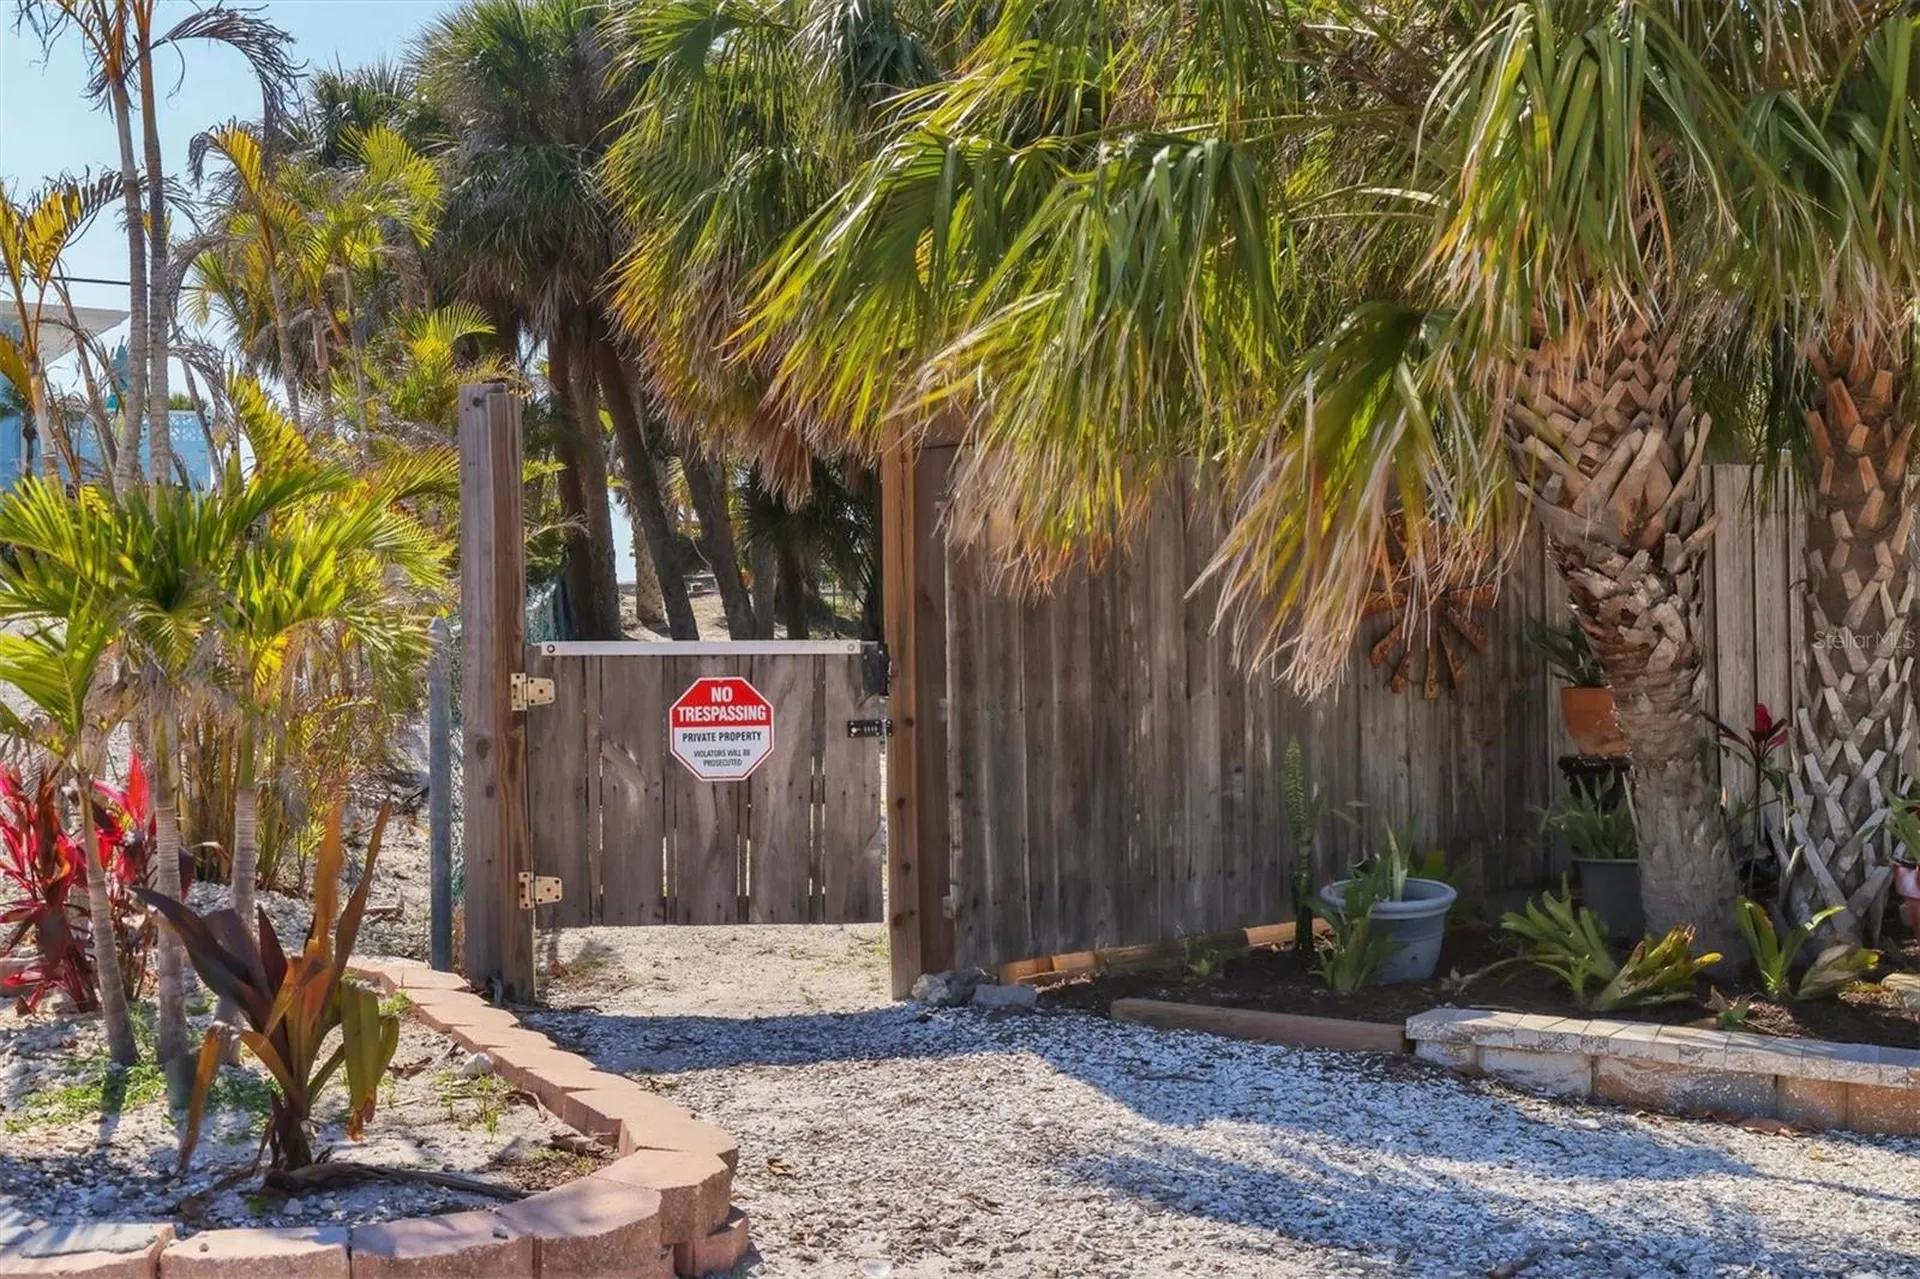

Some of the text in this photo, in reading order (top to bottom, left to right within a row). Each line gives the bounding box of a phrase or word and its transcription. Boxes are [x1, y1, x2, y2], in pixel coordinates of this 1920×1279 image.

[710, 686, 733, 703] NO
[677, 704, 767, 722] TRESPASSING
[682, 731, 762, 743] PRIVATE PROPERTY
[693, 748, 751, 758] VIOLATORS WILL BE
[703, 758, 743, 767] PROSECUTED
